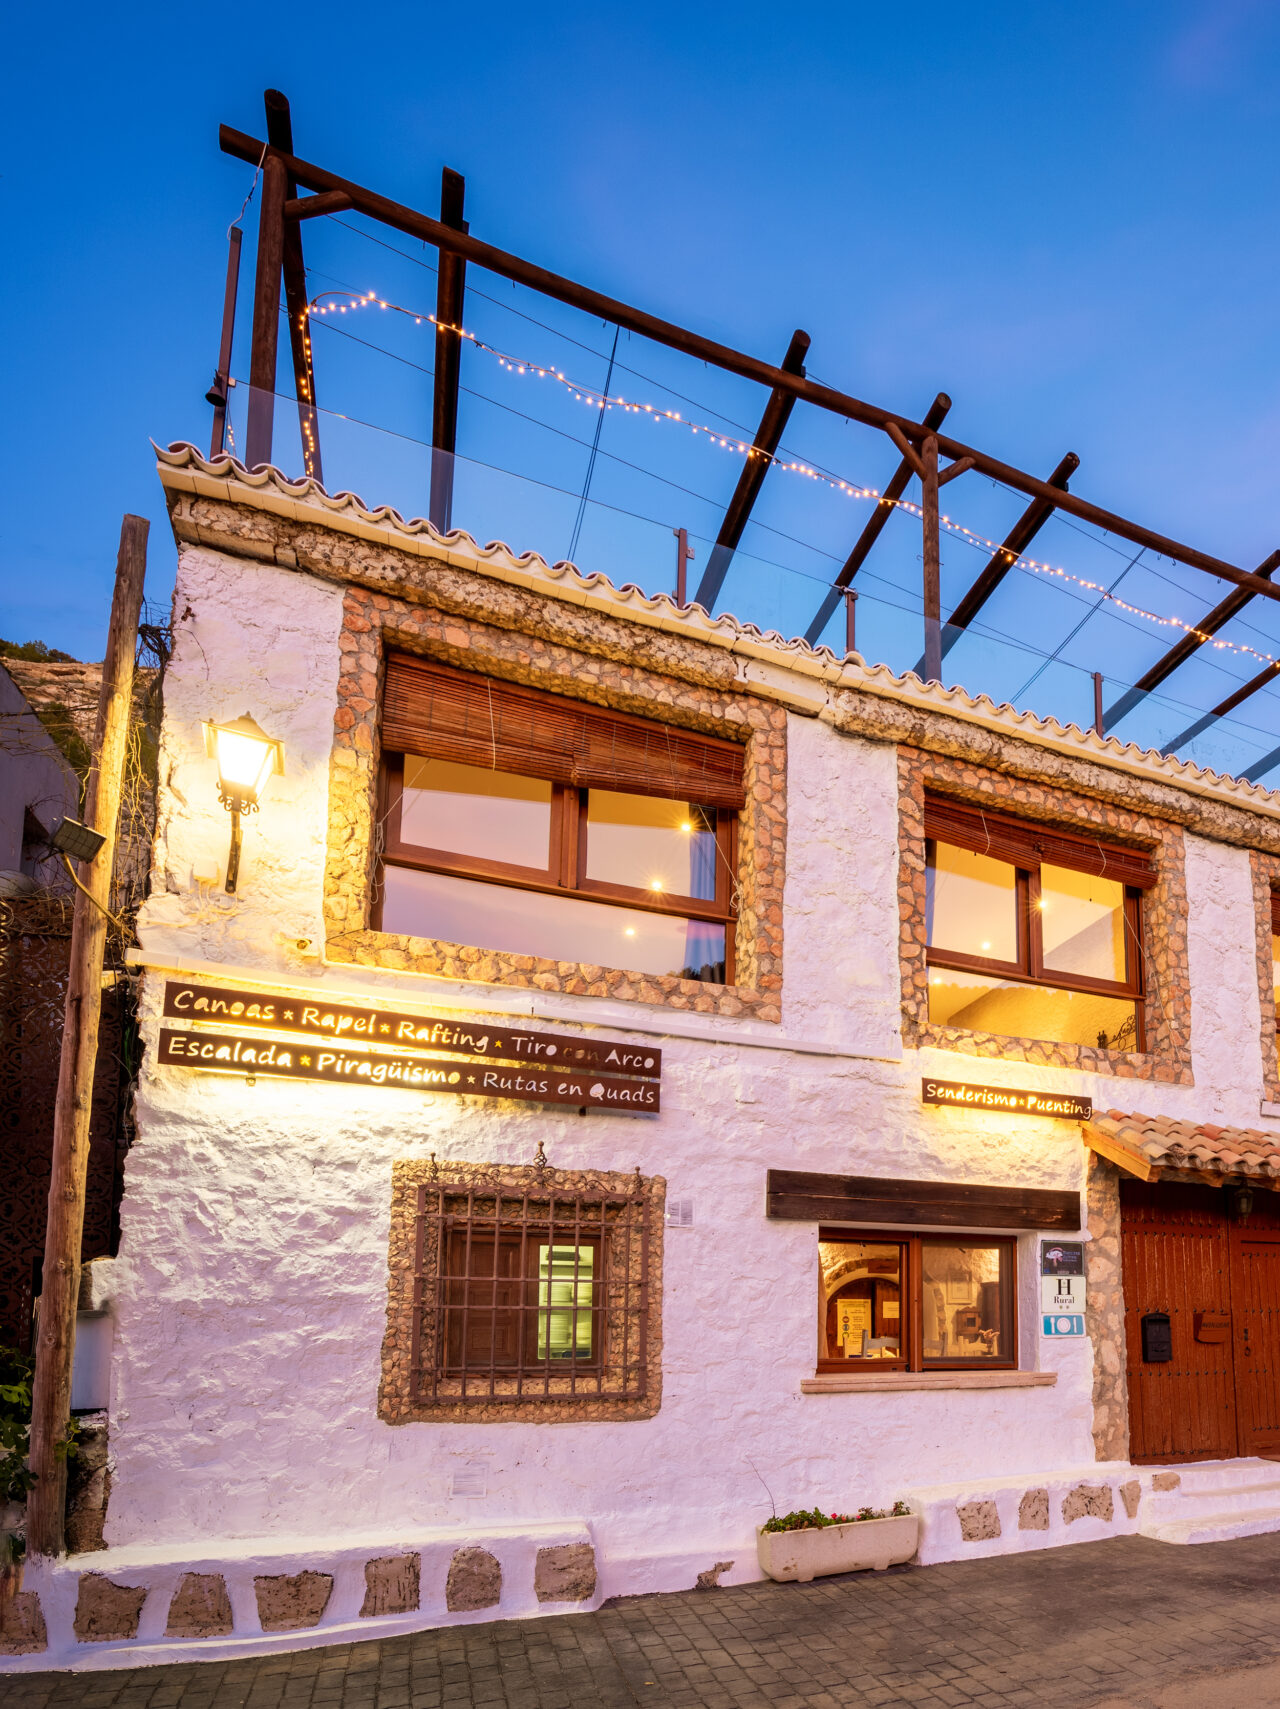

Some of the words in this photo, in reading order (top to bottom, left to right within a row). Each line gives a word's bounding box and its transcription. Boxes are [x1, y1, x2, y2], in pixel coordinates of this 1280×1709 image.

[174, 990, 275, 1020] Canoas
[302, 1007, 376, 1035] Rapel
[398, 1021, 489, 1053] Rafting
[511, 1036, 557, 1056] Tiro
[563, 1047, 599, 1061] con
[605, 1049, 655, 1069] Arco
[168, 1037, 292, 1067] Escalada
[317, 1053, 461, 1084] Piragüismo
[483, 1072, 548, 1093] Rutas
[557, 1081, 583, 1096] en
[590, 1083, 655, 1104] Quads
[926, 1083, 1017, 1107] Senderismo
[1027, 1096, 1092, 1120] Puenting
[1054, 1296, 1075, 1304] Rural
[1056, 1278, 1072, 1295] H
